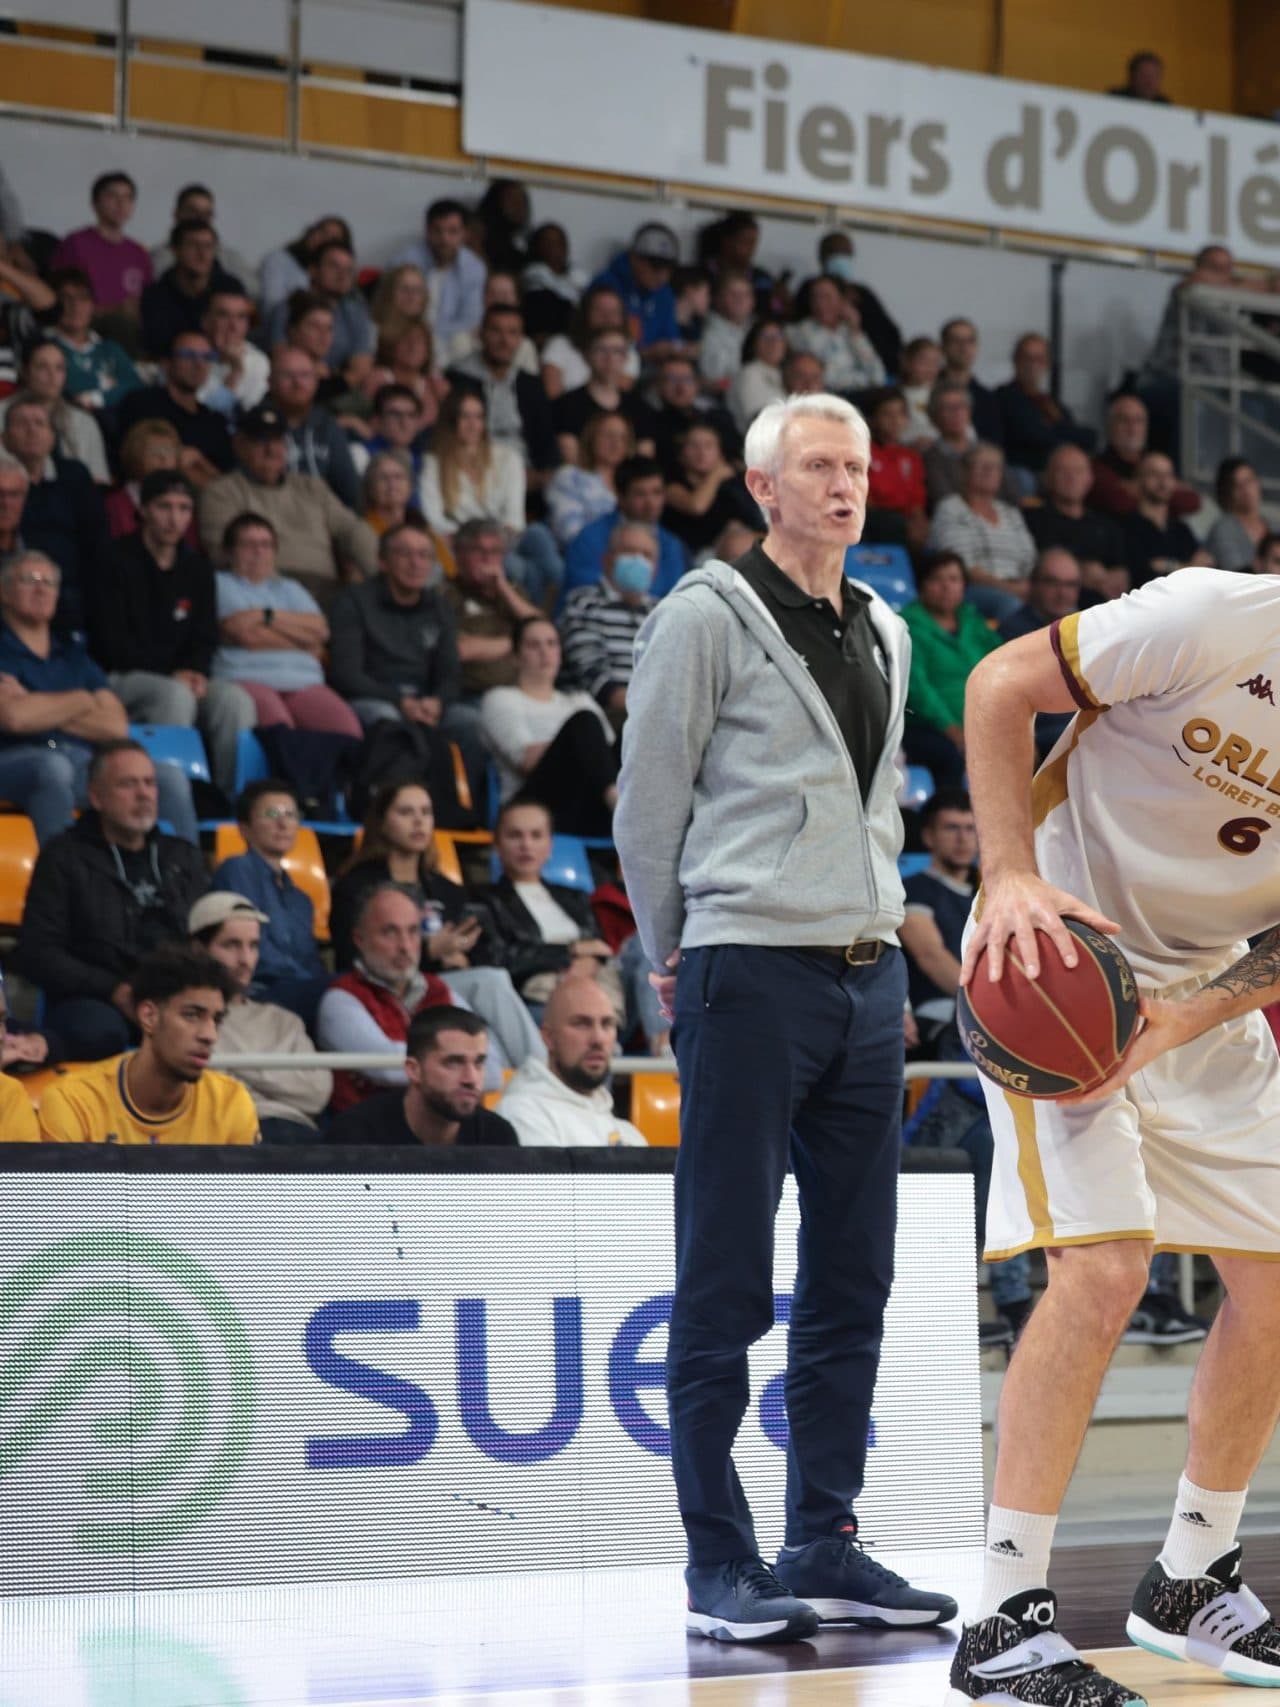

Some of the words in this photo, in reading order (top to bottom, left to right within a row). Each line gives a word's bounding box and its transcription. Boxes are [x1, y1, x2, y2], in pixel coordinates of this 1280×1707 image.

[704, 61, 951, 196] Fiers
[1193, 766, 1266, 808] LOIRET
[1217, 816, 1271, 856] 6
